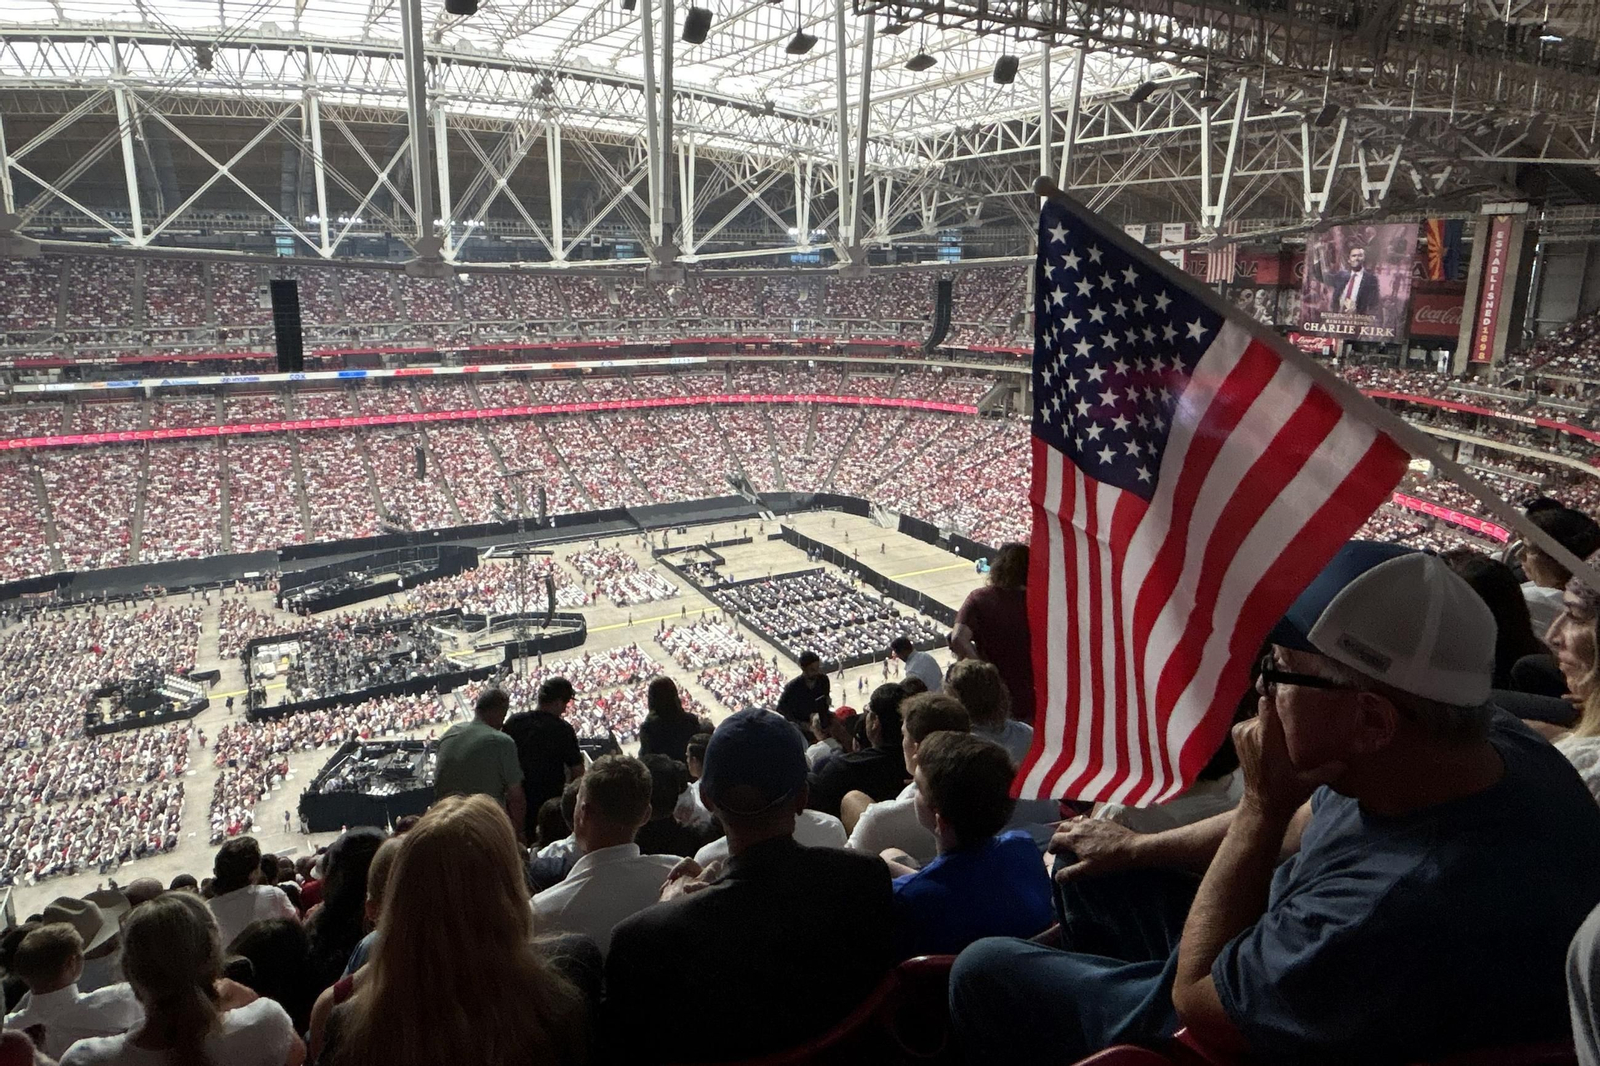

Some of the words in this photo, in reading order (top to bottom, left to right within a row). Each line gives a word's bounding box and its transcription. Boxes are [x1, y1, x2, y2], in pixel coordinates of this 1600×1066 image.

[1184, 260, 1259, 278] RIZNA
[1483, 231, 1505, 325] ESTABLISHED
[1415, 305, 1463, 325] Coca-Col
[1303, 322, 1356, 335] CHARLIE
[1359, 326, 1395, 337] KIRK
[1478, 327, 1489, 360] 1898
